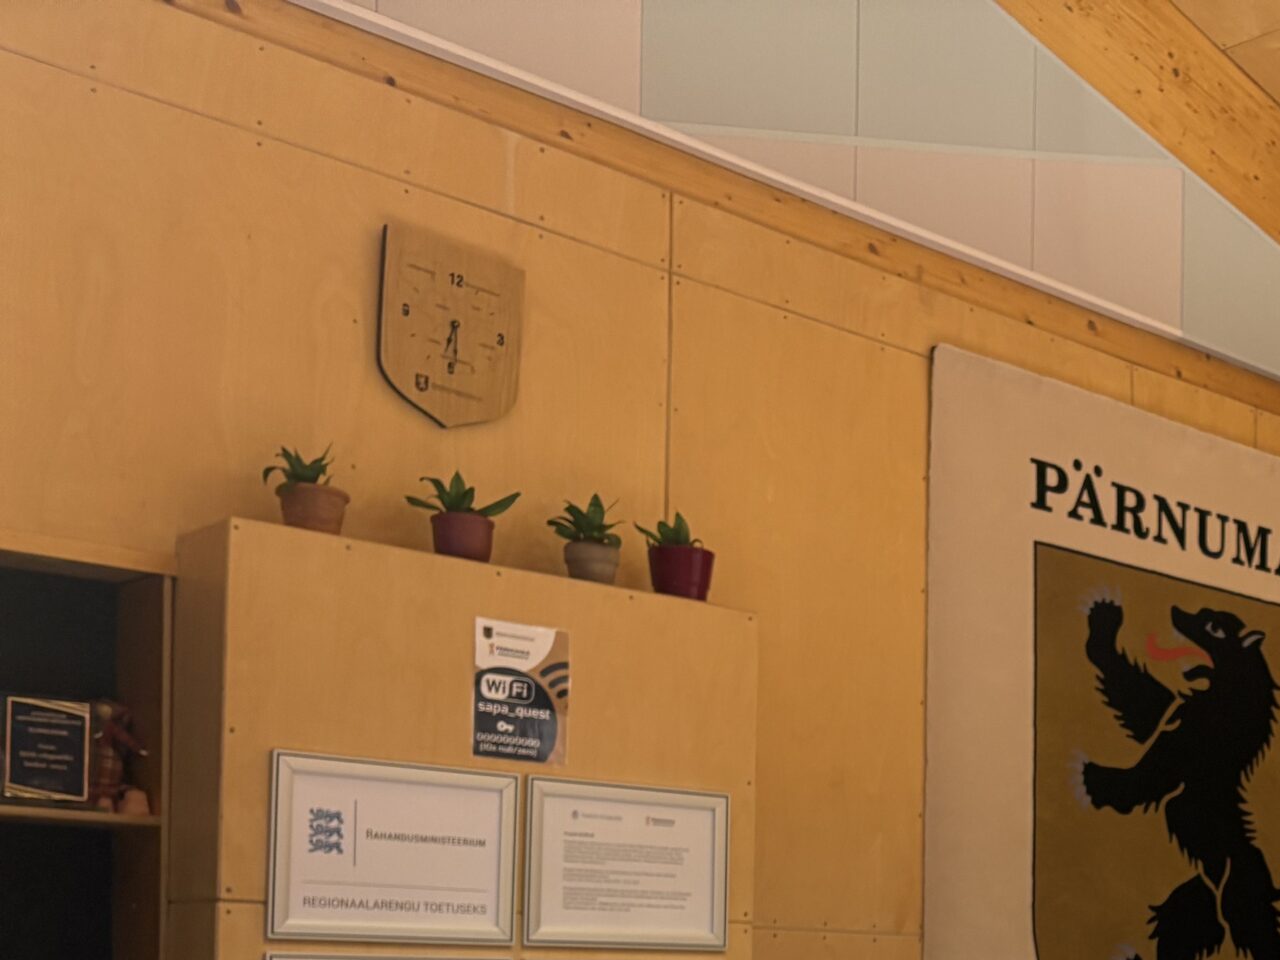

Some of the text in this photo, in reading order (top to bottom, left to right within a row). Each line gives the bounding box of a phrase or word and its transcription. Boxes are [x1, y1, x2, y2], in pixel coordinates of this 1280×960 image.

[449, 272, 464, 288] 12
[496, 332, 505, 347] 3
[302, 896, 487, 915] REGIONAALARENGU TOETUSEKS
